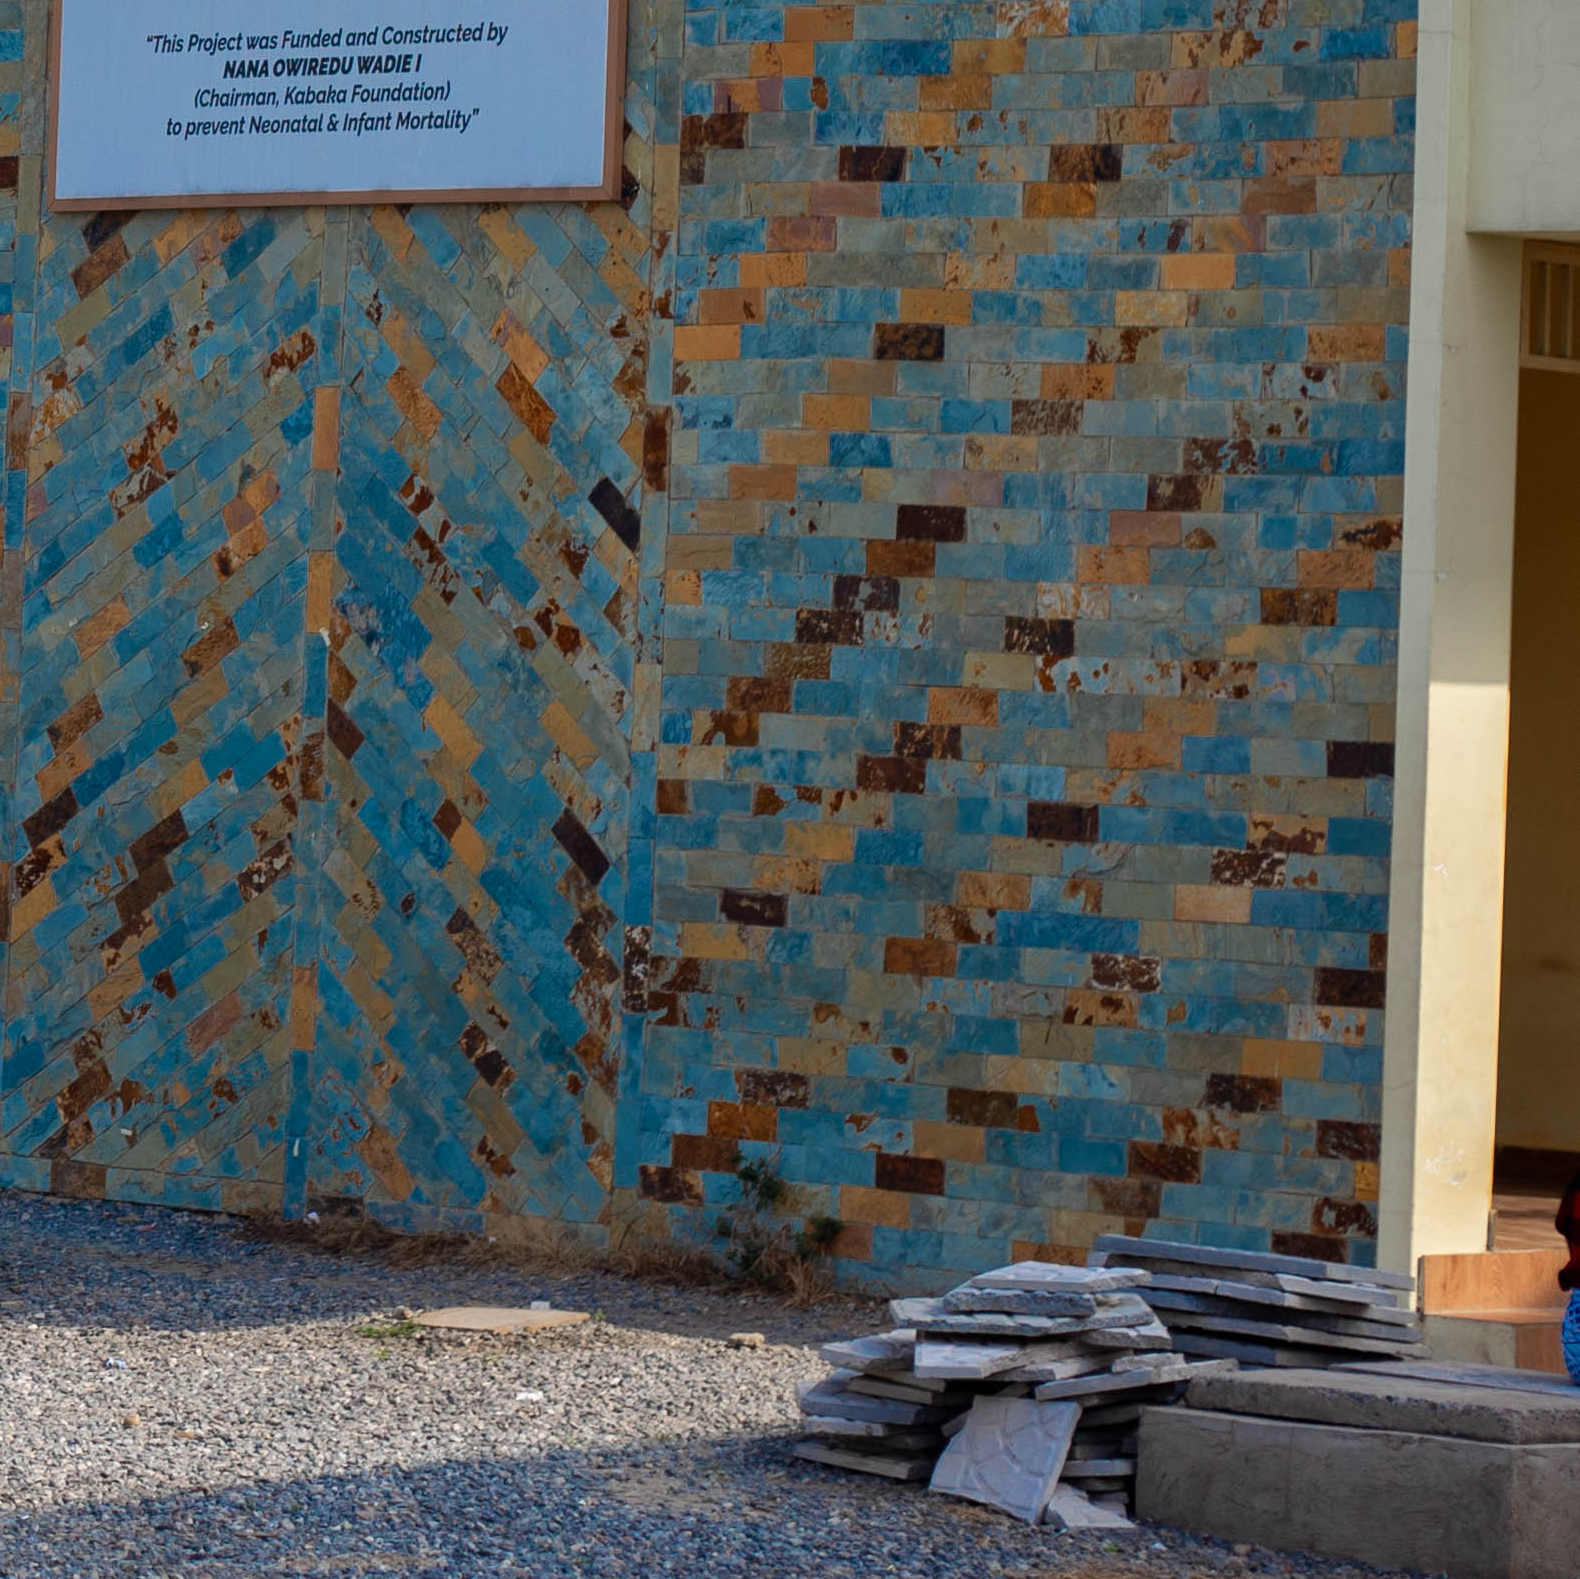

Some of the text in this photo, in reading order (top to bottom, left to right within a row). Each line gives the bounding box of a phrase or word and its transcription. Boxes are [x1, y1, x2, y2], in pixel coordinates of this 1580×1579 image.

[187, 32, 243, 55] Project
[247, 34, 278, 50] was
[281, 28, 343, 49] Funded
[345, 26, 379, 47] and
[382, 22, 485, 45] Constructed
[486, 21, 508, 46] by
[223, 53, 423, 79] NANA OWIREDU WADIE I
[194, 80, 451, 109] (Chairman, Kabaka Foundation)
[166, 118, 182, 136] to
[184, 116, 245, 140] prevent
[249, 113, 323, 134] Neonatal
[327, 113, 339, 132] &
[342, 111, 392, 136] Infant
